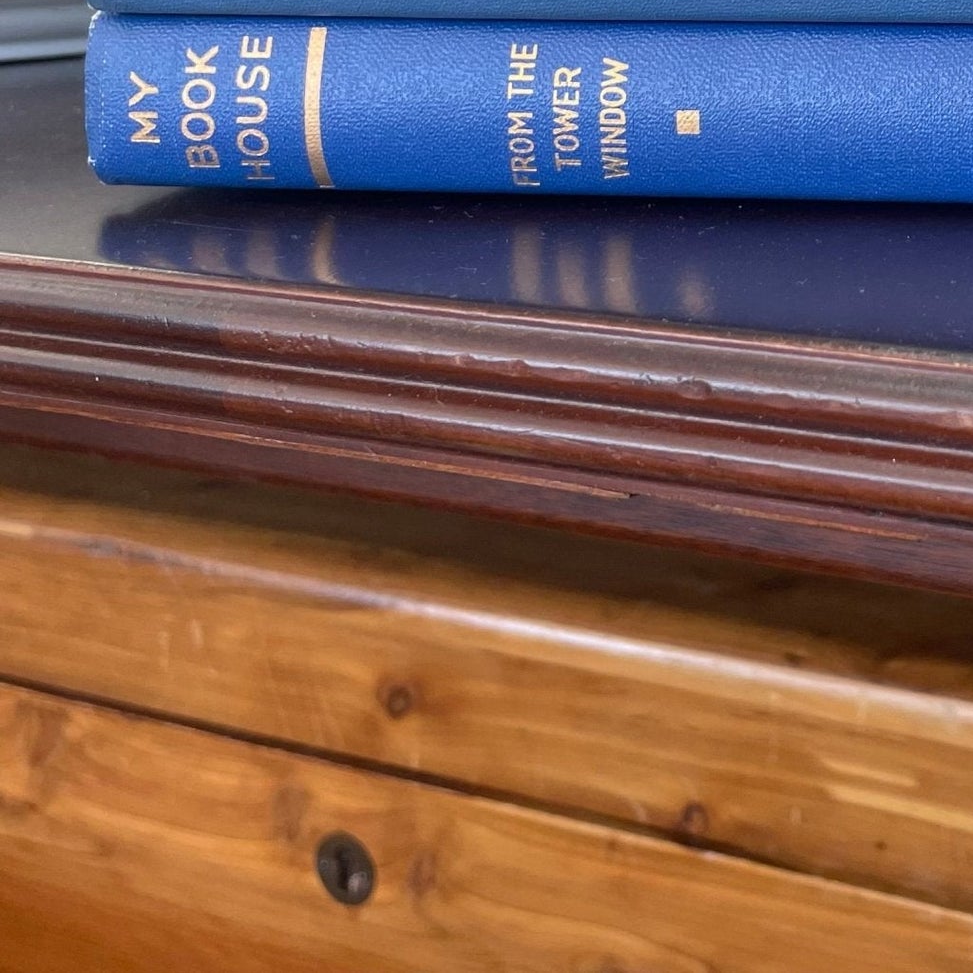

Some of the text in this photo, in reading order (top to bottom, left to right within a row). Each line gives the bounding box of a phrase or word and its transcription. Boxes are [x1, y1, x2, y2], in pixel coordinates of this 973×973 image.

[129, 72, 160, 144] MY
[181, 45, 221, 169] BOOK
[235, 35, 274, 182] HOUSE
[508, 43, 540, 187] FROM THE
[551, 67, 582, 169] TOWER
[600, 57, 629, 179] WINDOW
